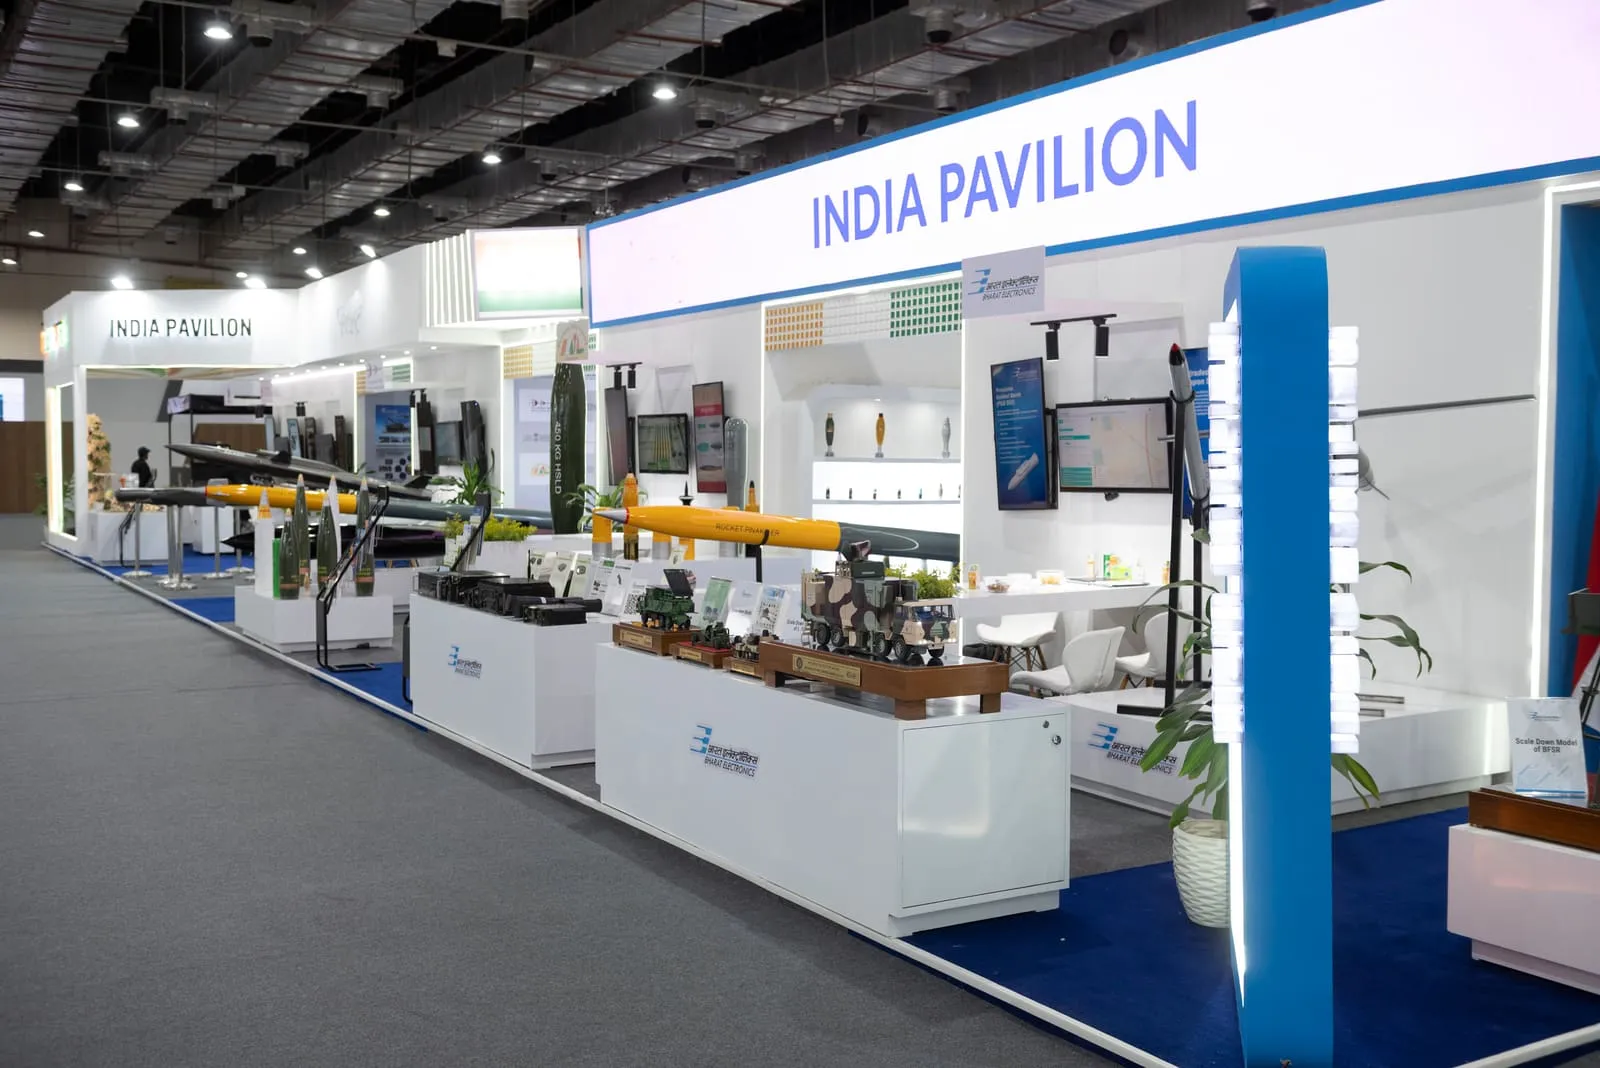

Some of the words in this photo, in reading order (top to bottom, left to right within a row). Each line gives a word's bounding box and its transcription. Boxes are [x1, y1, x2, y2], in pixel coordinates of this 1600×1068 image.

[812, 172, 927, 249] INDIA
[940, 99, 1198, 223] PAVILION
[982, 291, 1001, 302] BHARAT
[1001, 286, 1036, 298] ELECTRONICS
[110, 318, 160, 338] INDIA
[166, 317, 252, 337] PAVILION
[554, 421, 562, 441] 450
[554, 444, 562, 460] KG
[554, 463, 562, 494] HSLD
[1515, 737, 1534, 745] Scale
[1556, 738, 1578, 746] Model
[1533, 745, 1541, 753] of
[1107, 751, 1130, 763] BHARAT
[704, 756, 723, 768] BHARAT
[722, 760, 756, 777] ELECTRONICS
